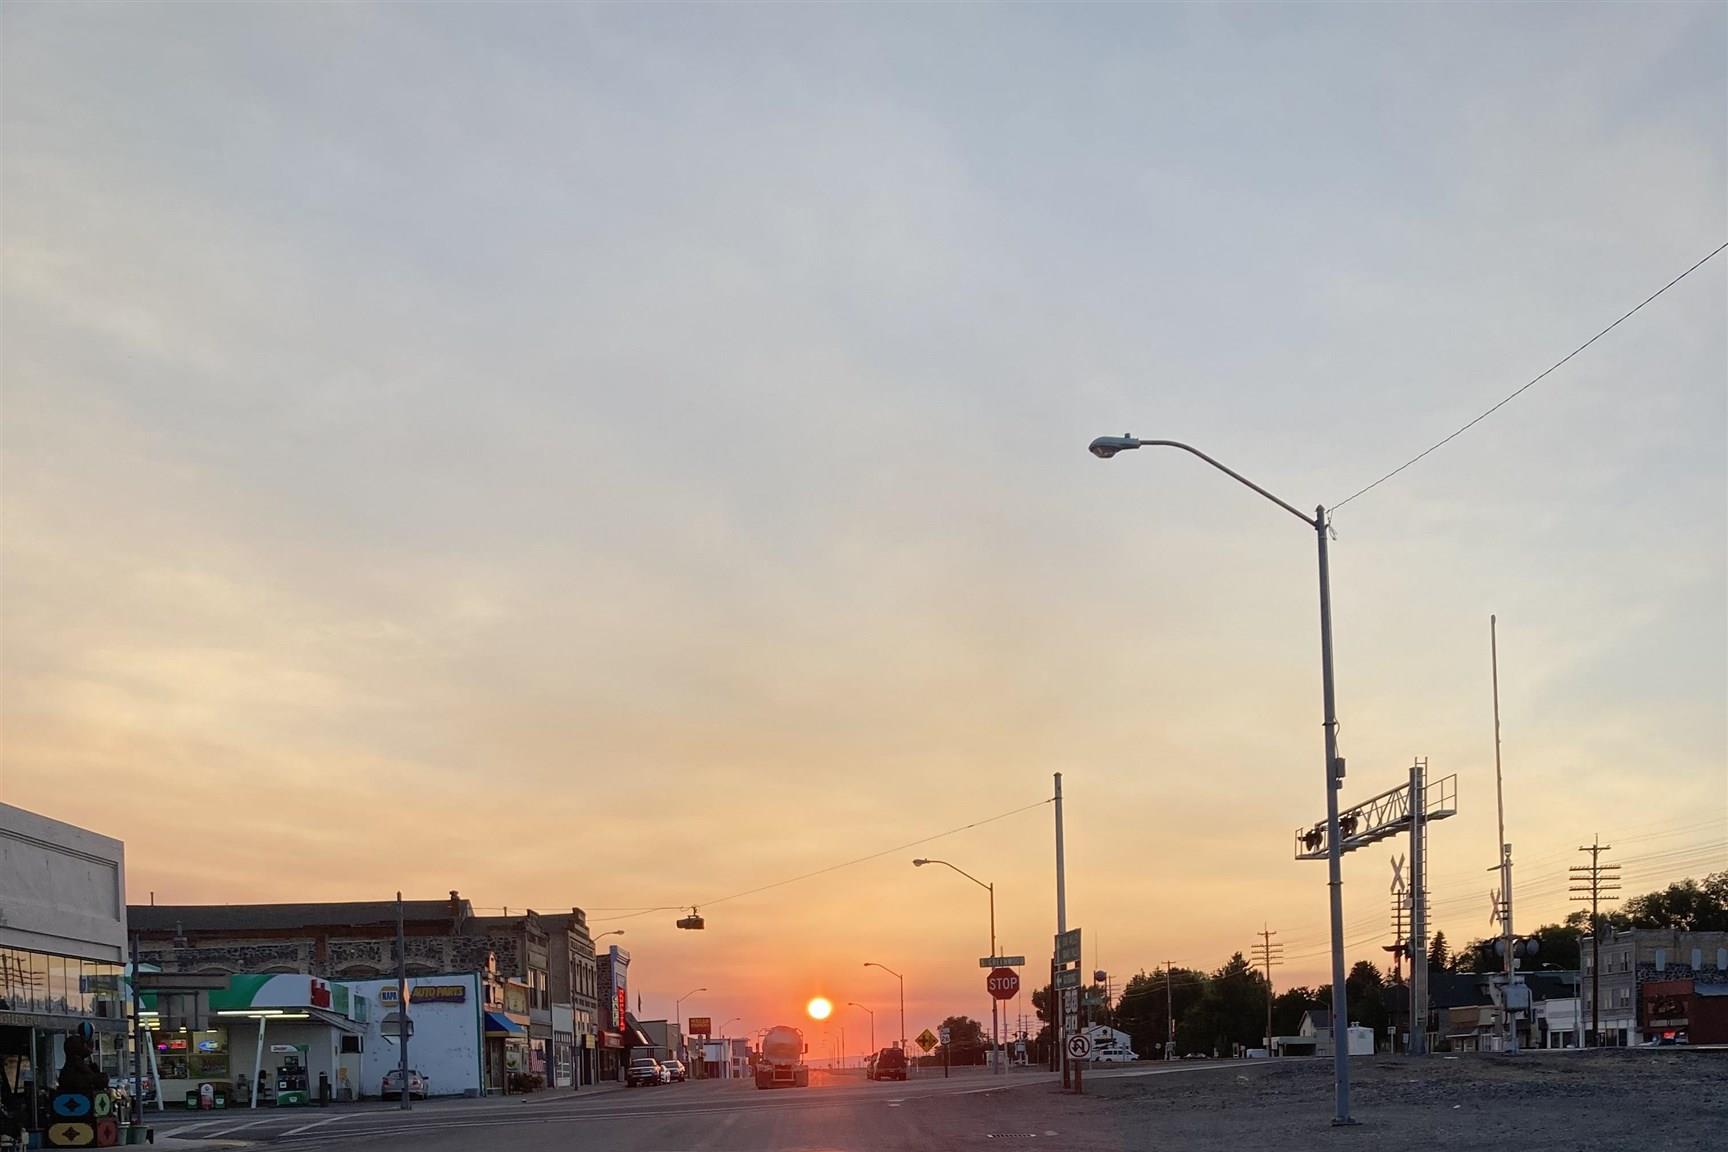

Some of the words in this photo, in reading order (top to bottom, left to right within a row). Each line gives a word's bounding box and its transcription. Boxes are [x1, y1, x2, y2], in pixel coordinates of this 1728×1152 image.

[989, 977, 1018, 991] STOP
[382, 991, 397, 1000] NAPA
[412, 987, 435, 997] AUTO
